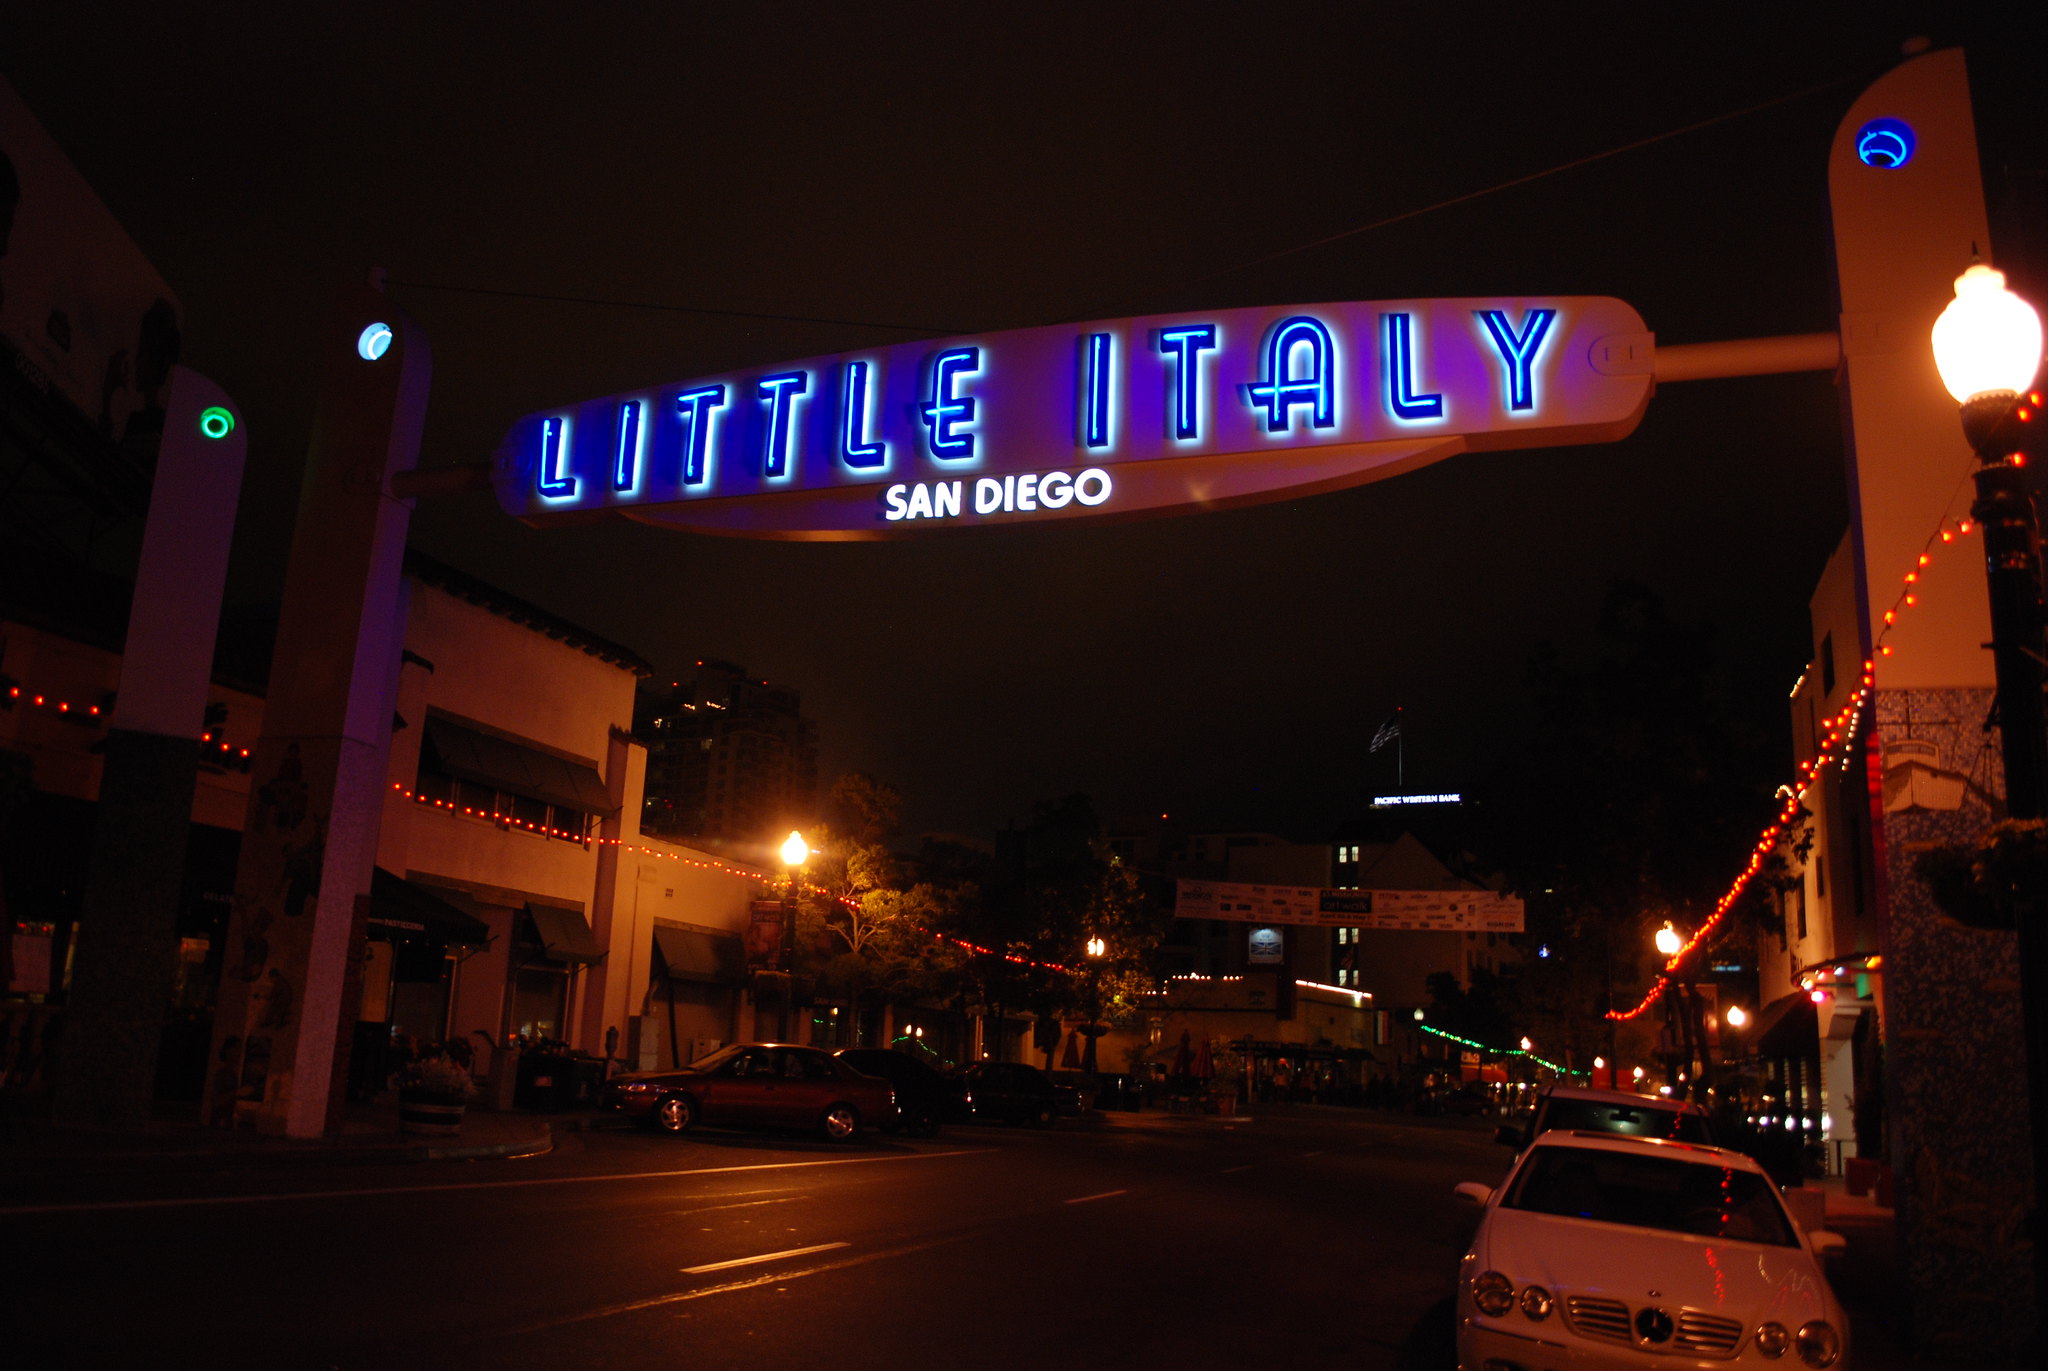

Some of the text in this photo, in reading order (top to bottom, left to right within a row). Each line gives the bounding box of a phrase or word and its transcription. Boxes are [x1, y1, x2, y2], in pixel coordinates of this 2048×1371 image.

[537, 309, 1556, 498] LITTLE ITALY
[886, 468, 1112, 521] SAN DIEGO
[1374, 793, 1460, 805] PACIFIC WESTERN BANK
